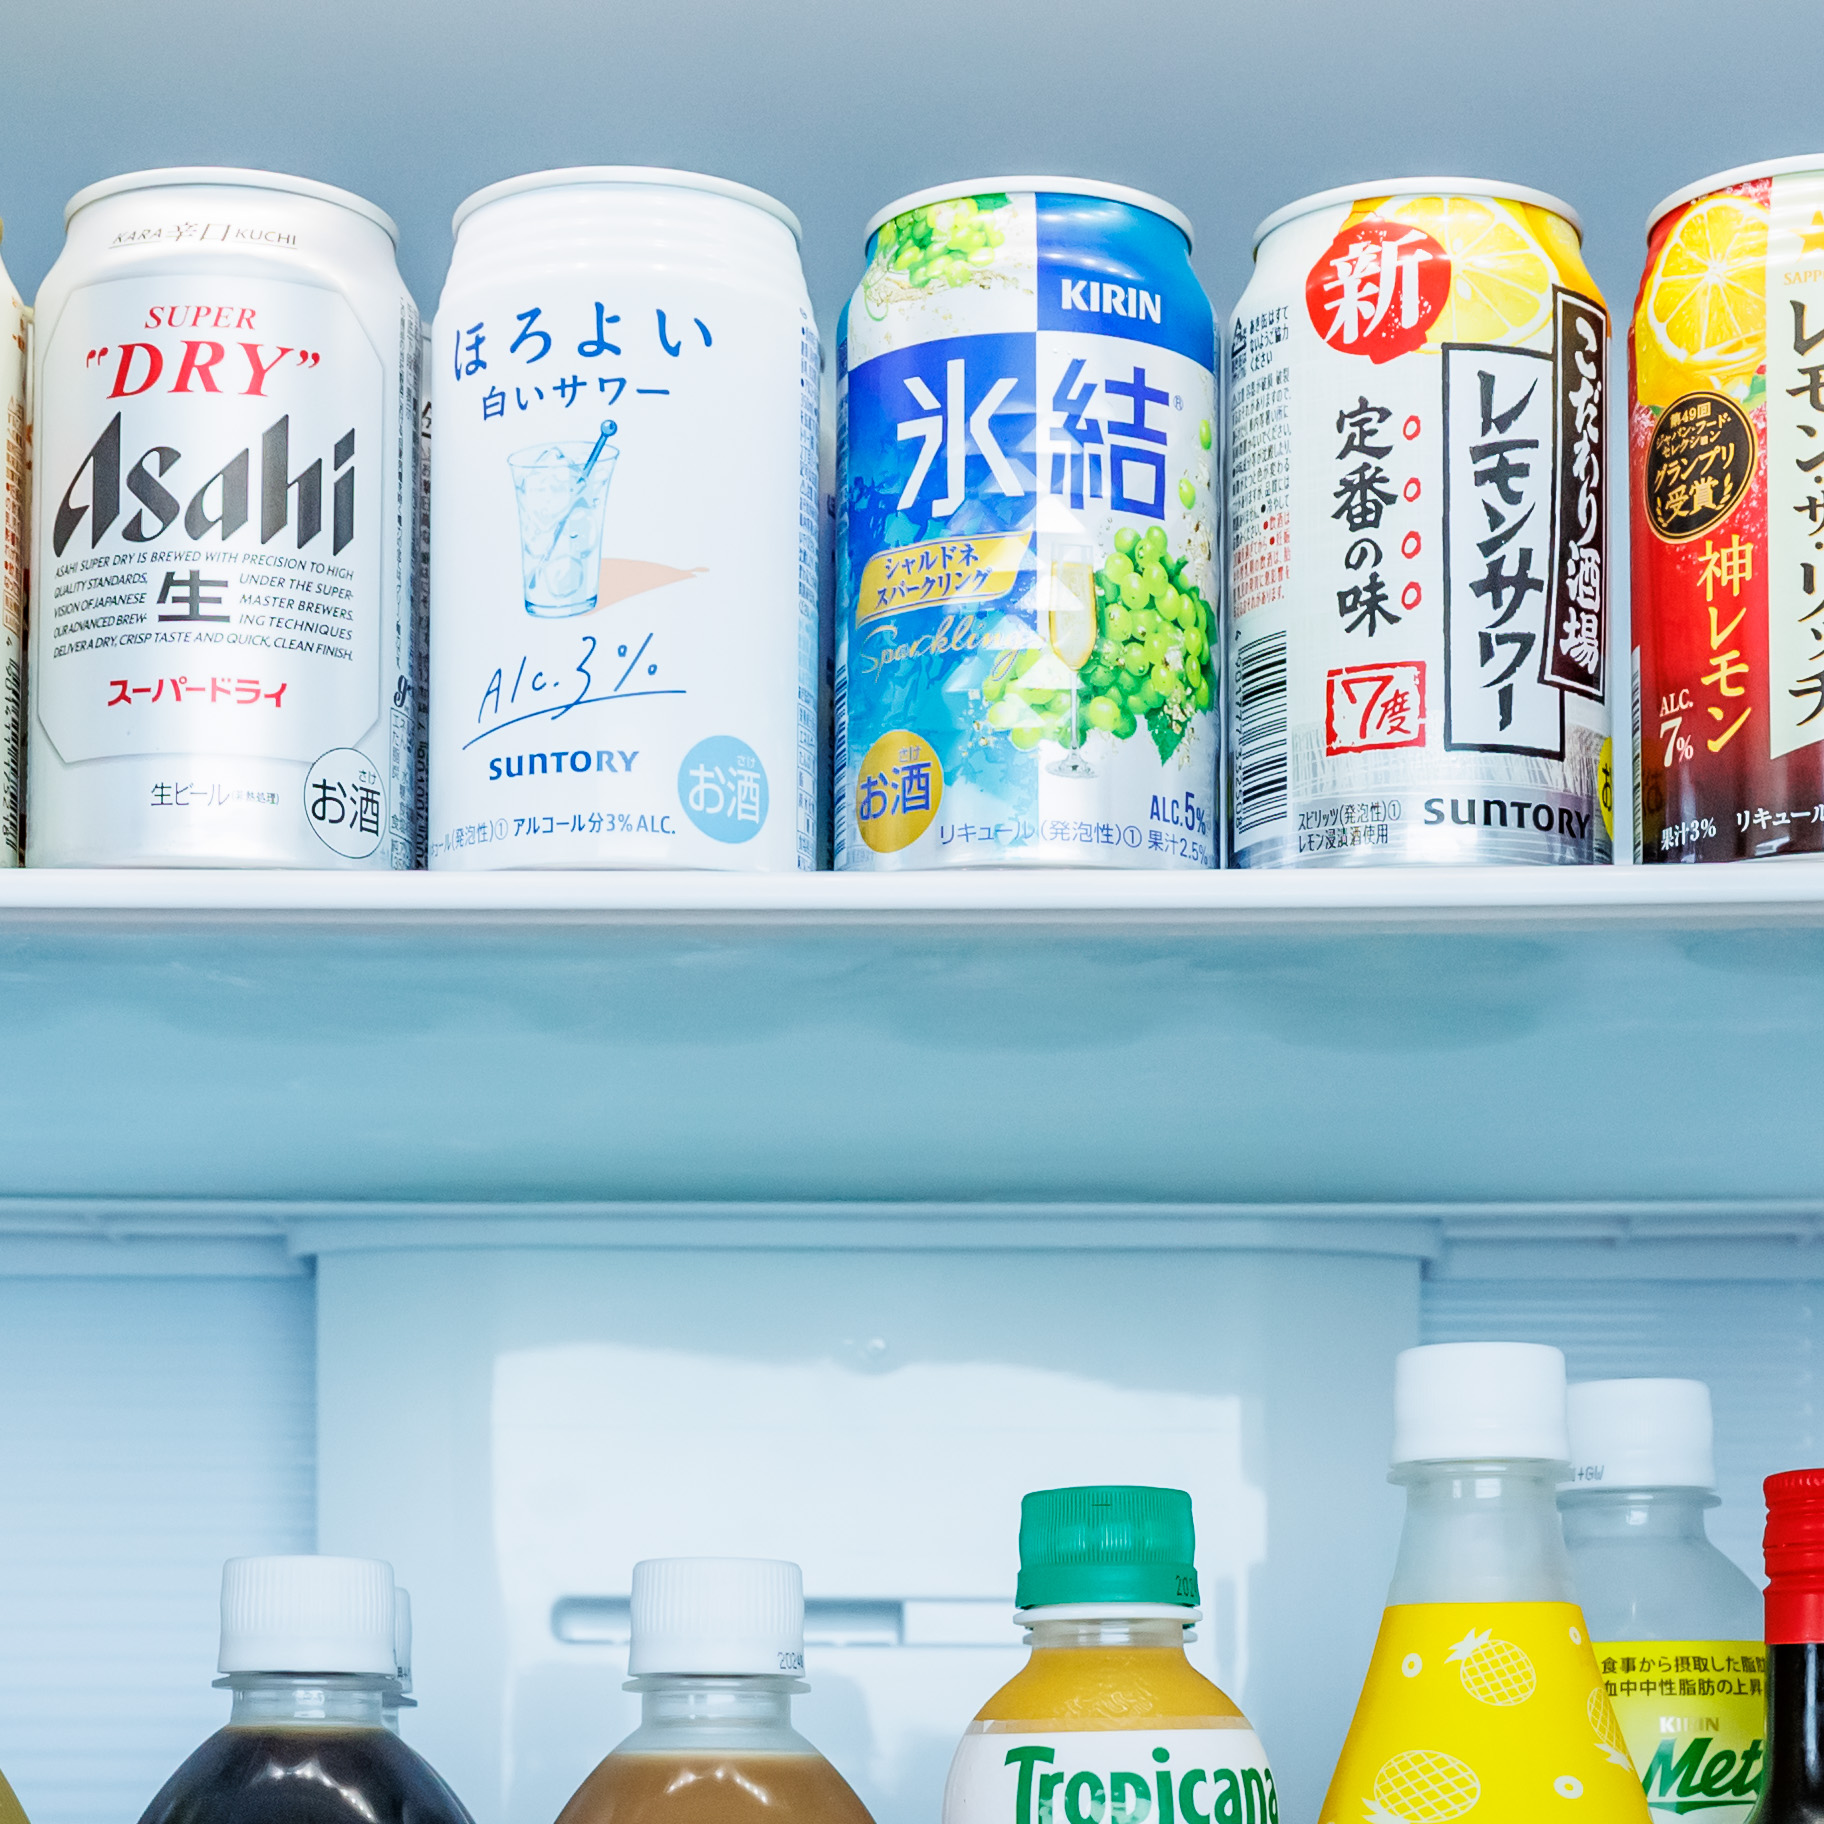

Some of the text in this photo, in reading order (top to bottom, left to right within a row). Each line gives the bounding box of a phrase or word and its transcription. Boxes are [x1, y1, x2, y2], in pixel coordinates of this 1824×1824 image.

[236, 228, 296, 245] KUCHI
[1061, 278, 1162, 324] KIRIN
[1325, 229, 1433, 346] 新
[144, 305, 257, 331] SUPER
[454, 301, 714, 380] ほろよい
[482, 375, 670, 421] 白いサワー
[1670, 402, 1711, 428] 第49回
[896, 358, 1171, 520] 氷結
[53, 411, 355, 557] Asahi
[1559, 316, 1603, 676] こだわり酒場
[1330, 395, 1402, 638] 定番の味
[80, 551, 354, 581] SUPER DRY BREWED WITH PRECISION HIGH
[883, 540, 979, 581] シャルドネ
[1469, 369, 1545, 731] レモンサワー
[156, 569, 230, 622] 生
[239, 573, 313, 592] UNDER THE
[240, 594, 294, 610] MASTER
[875, 568, 993, 610] スパークリング
[119, 632, 314, 652] CRISP TASTE AND CLEAN
[239, 614, 353, 640] ING TECHNIQUES
[858, 614, 1047, 684] Sparkling
[1696, 534, 1755, 754] 神レモン
[108, 677, 288, 708] スーパードライ
[1660, 689, 1693, 717] ALC.
[1660, 717, 1694, 767] 7%
[489, 751, 639, 781] SUNTORY
[312, 779, 380, 837] お酒
[689, 764, 761, 824] お酒
[859, 761, 932, 821] お酒
[1424, 798, 1591, 840] SUNTORY
[1660, 1717, 1719, 1733] KIRIN
